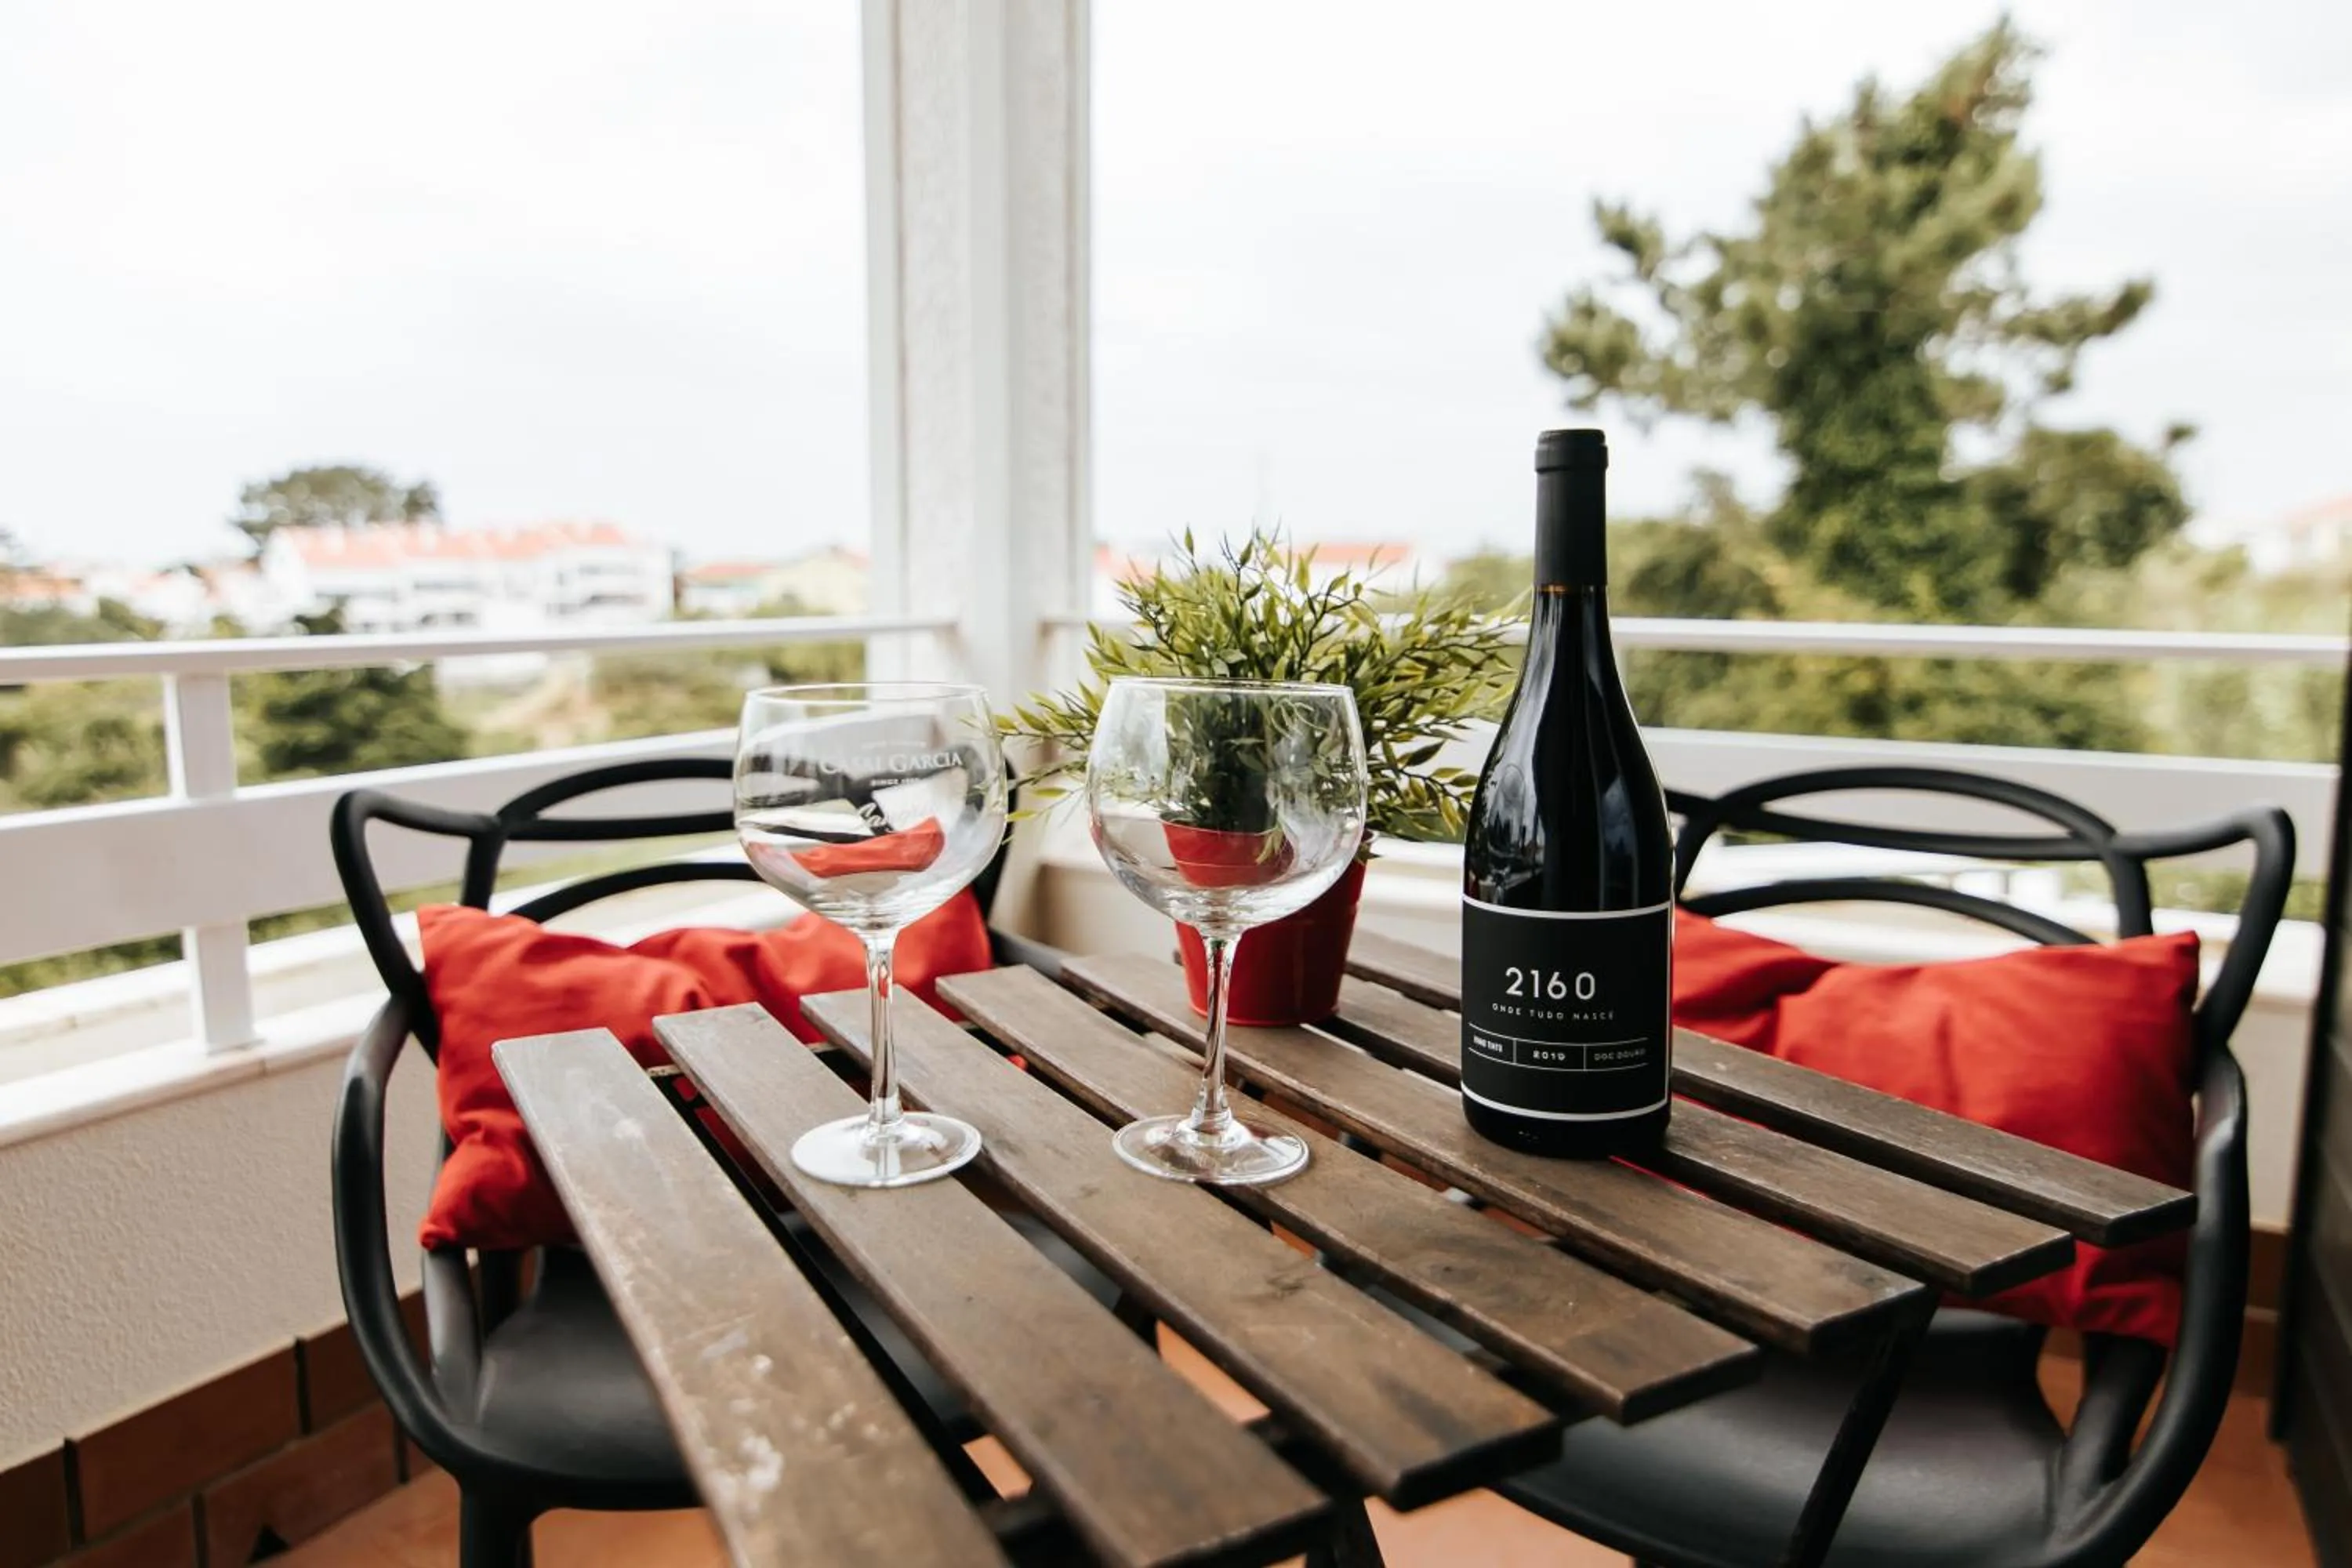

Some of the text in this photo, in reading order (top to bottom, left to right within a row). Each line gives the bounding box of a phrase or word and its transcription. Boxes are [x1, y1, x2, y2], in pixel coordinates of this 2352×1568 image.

[888, 752, 963, 772] GARCIA
[1505, 967, 1596, 1000] 2160
[1492, 1003, 1522, 1016] ONDE
[1530, 1009, 1565, 1020] TUDO
